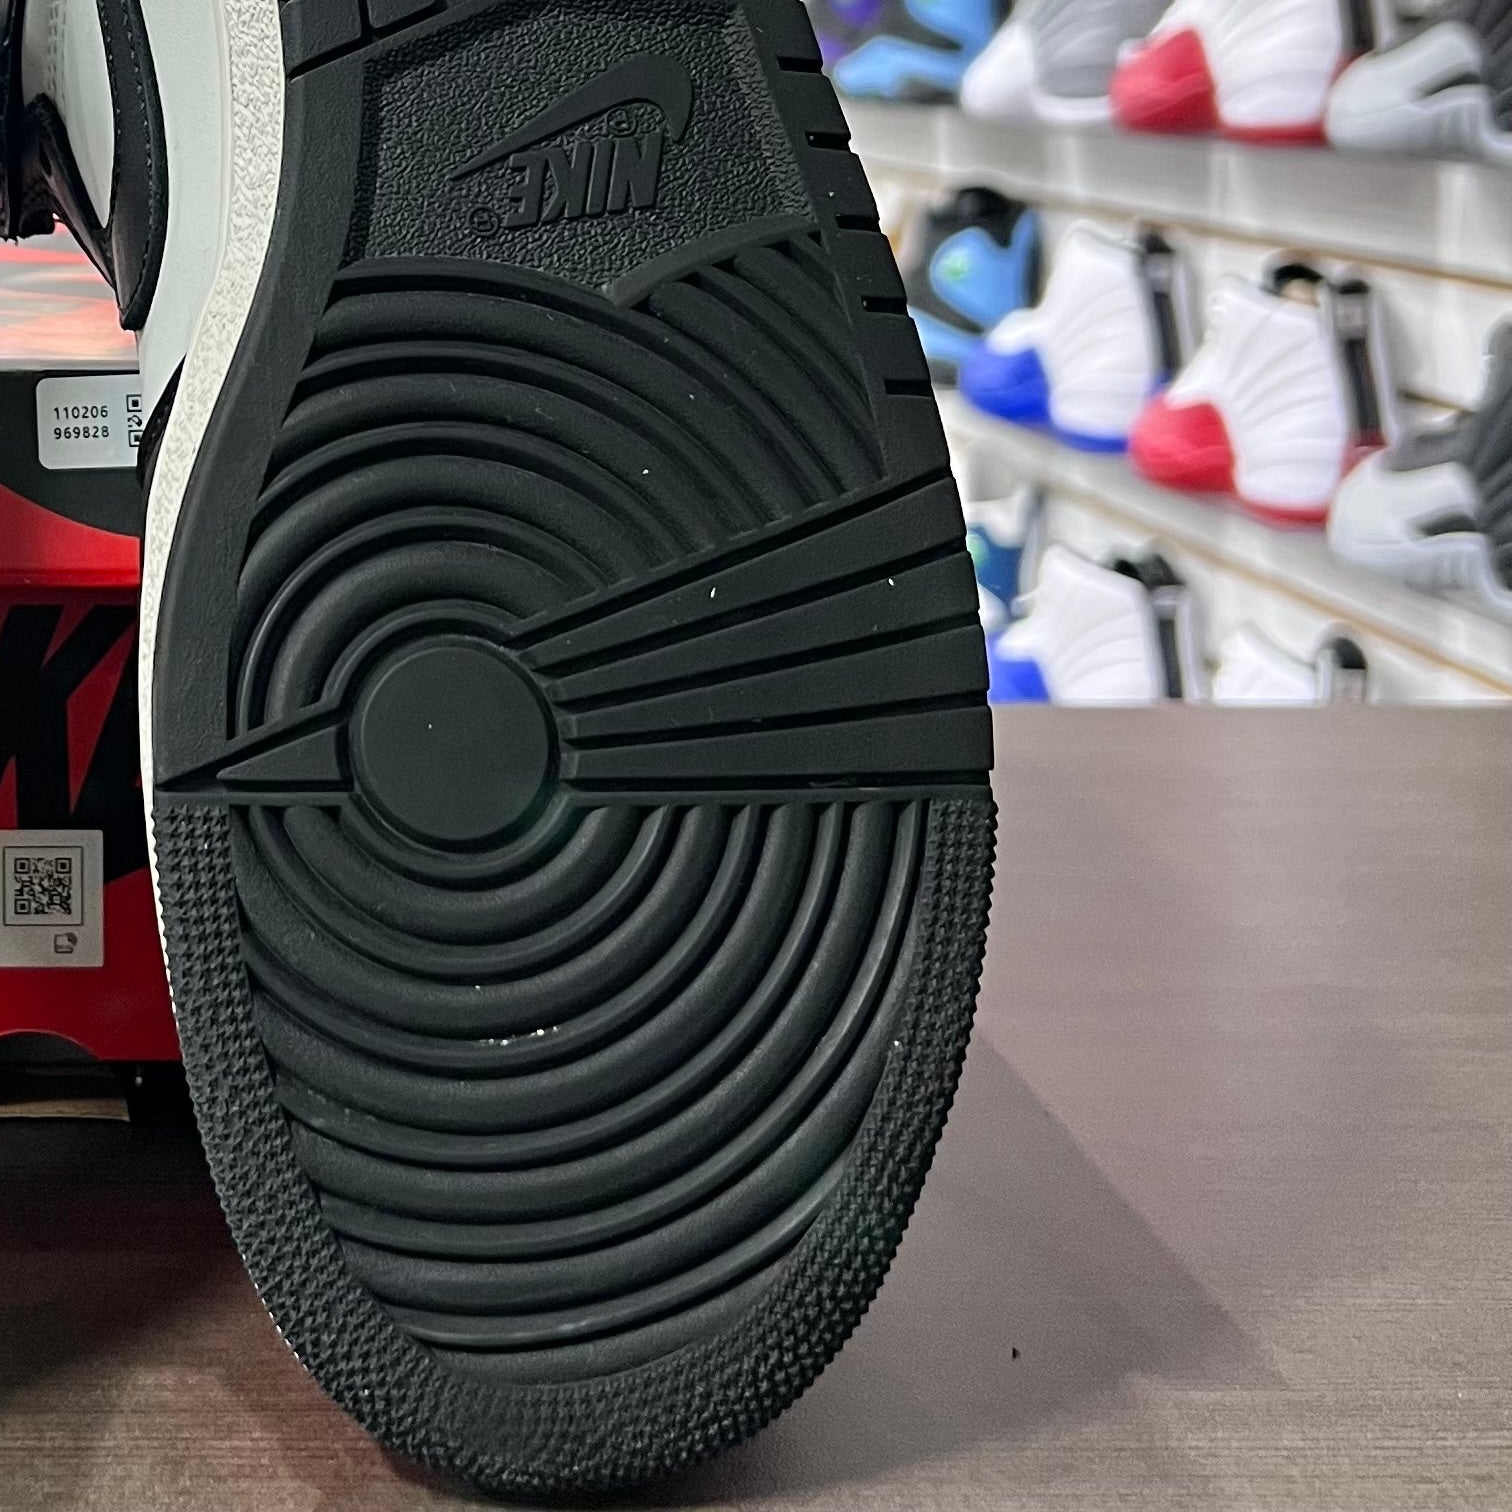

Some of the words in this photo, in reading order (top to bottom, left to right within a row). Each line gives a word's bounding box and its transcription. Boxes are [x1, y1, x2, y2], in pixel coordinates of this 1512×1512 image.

[500, 131, 665, 230] NIKE
[52, 404, 109, 420] 110206
[53, 425, 110, 440] 969828
